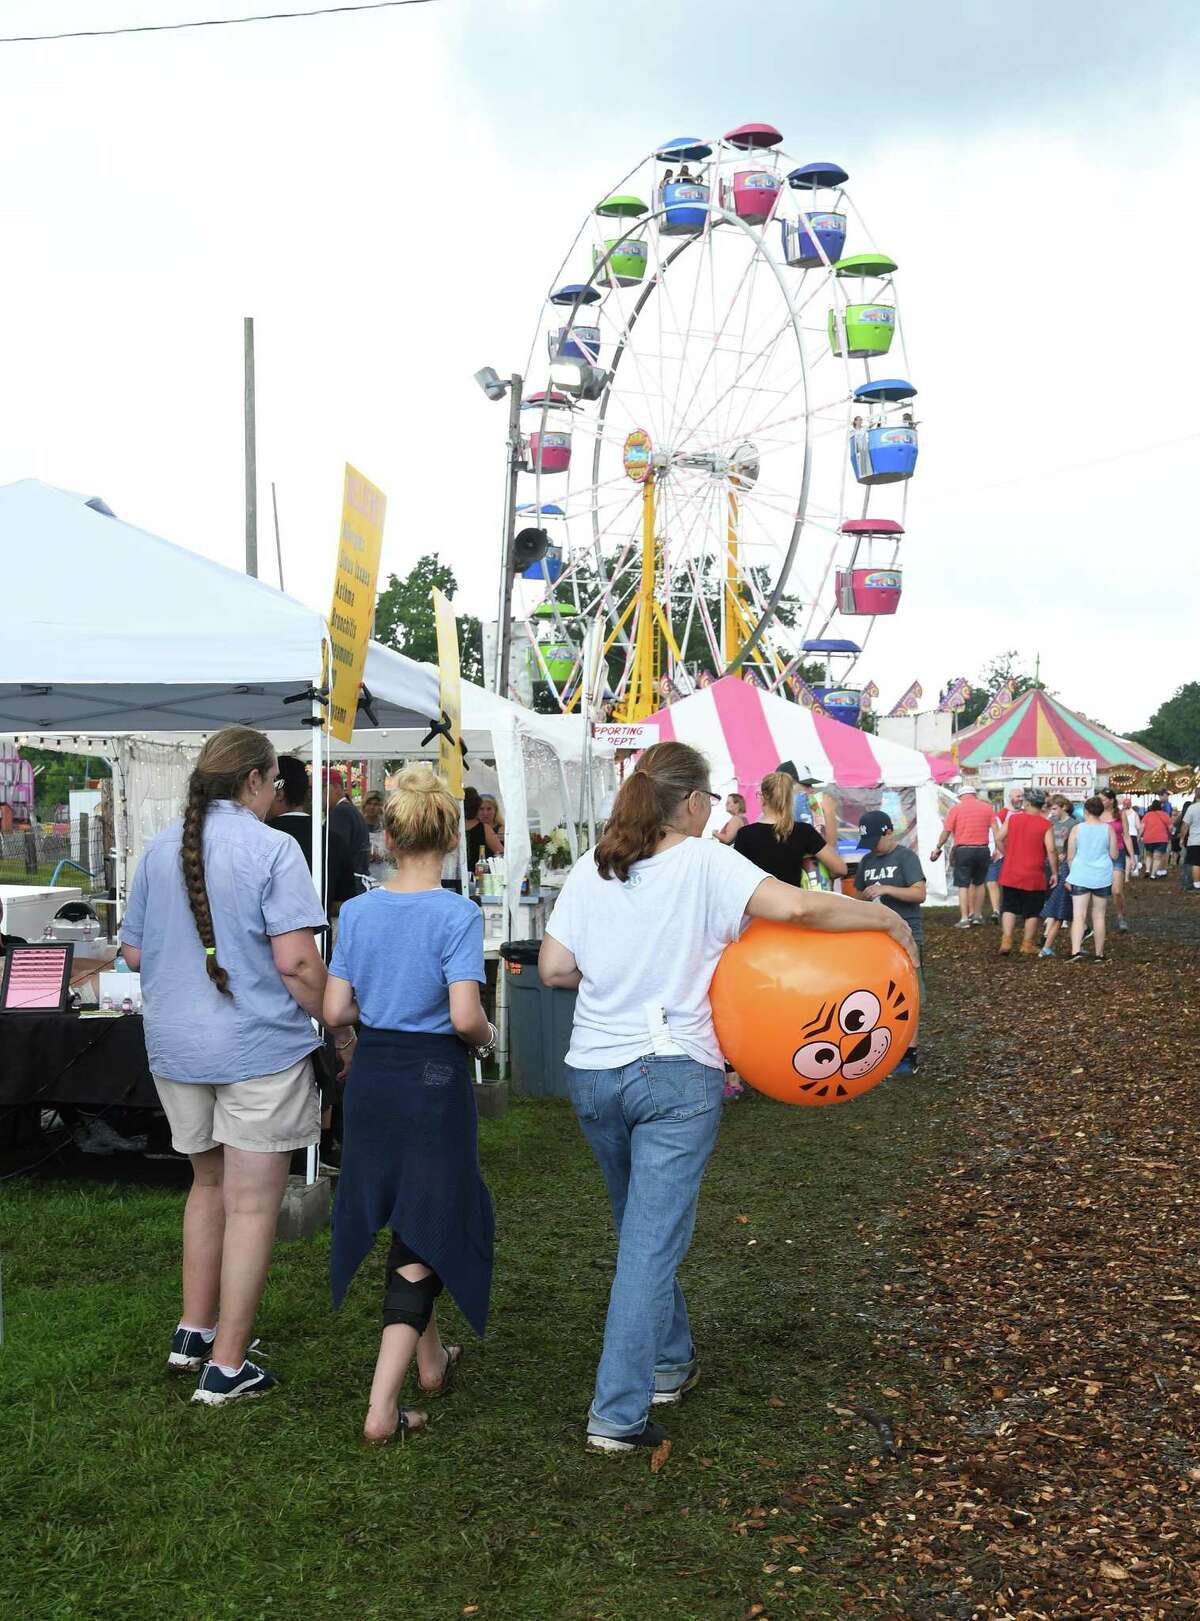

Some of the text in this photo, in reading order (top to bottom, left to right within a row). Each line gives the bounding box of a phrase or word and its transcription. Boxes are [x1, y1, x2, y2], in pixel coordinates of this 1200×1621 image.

[336, 577, 355, 606] Asthma
[1050, 760, 1092, 775] TICKETS
[1038, 776, 1088, 787] TICKETS
[864, 865, 898, 881] PLAY
